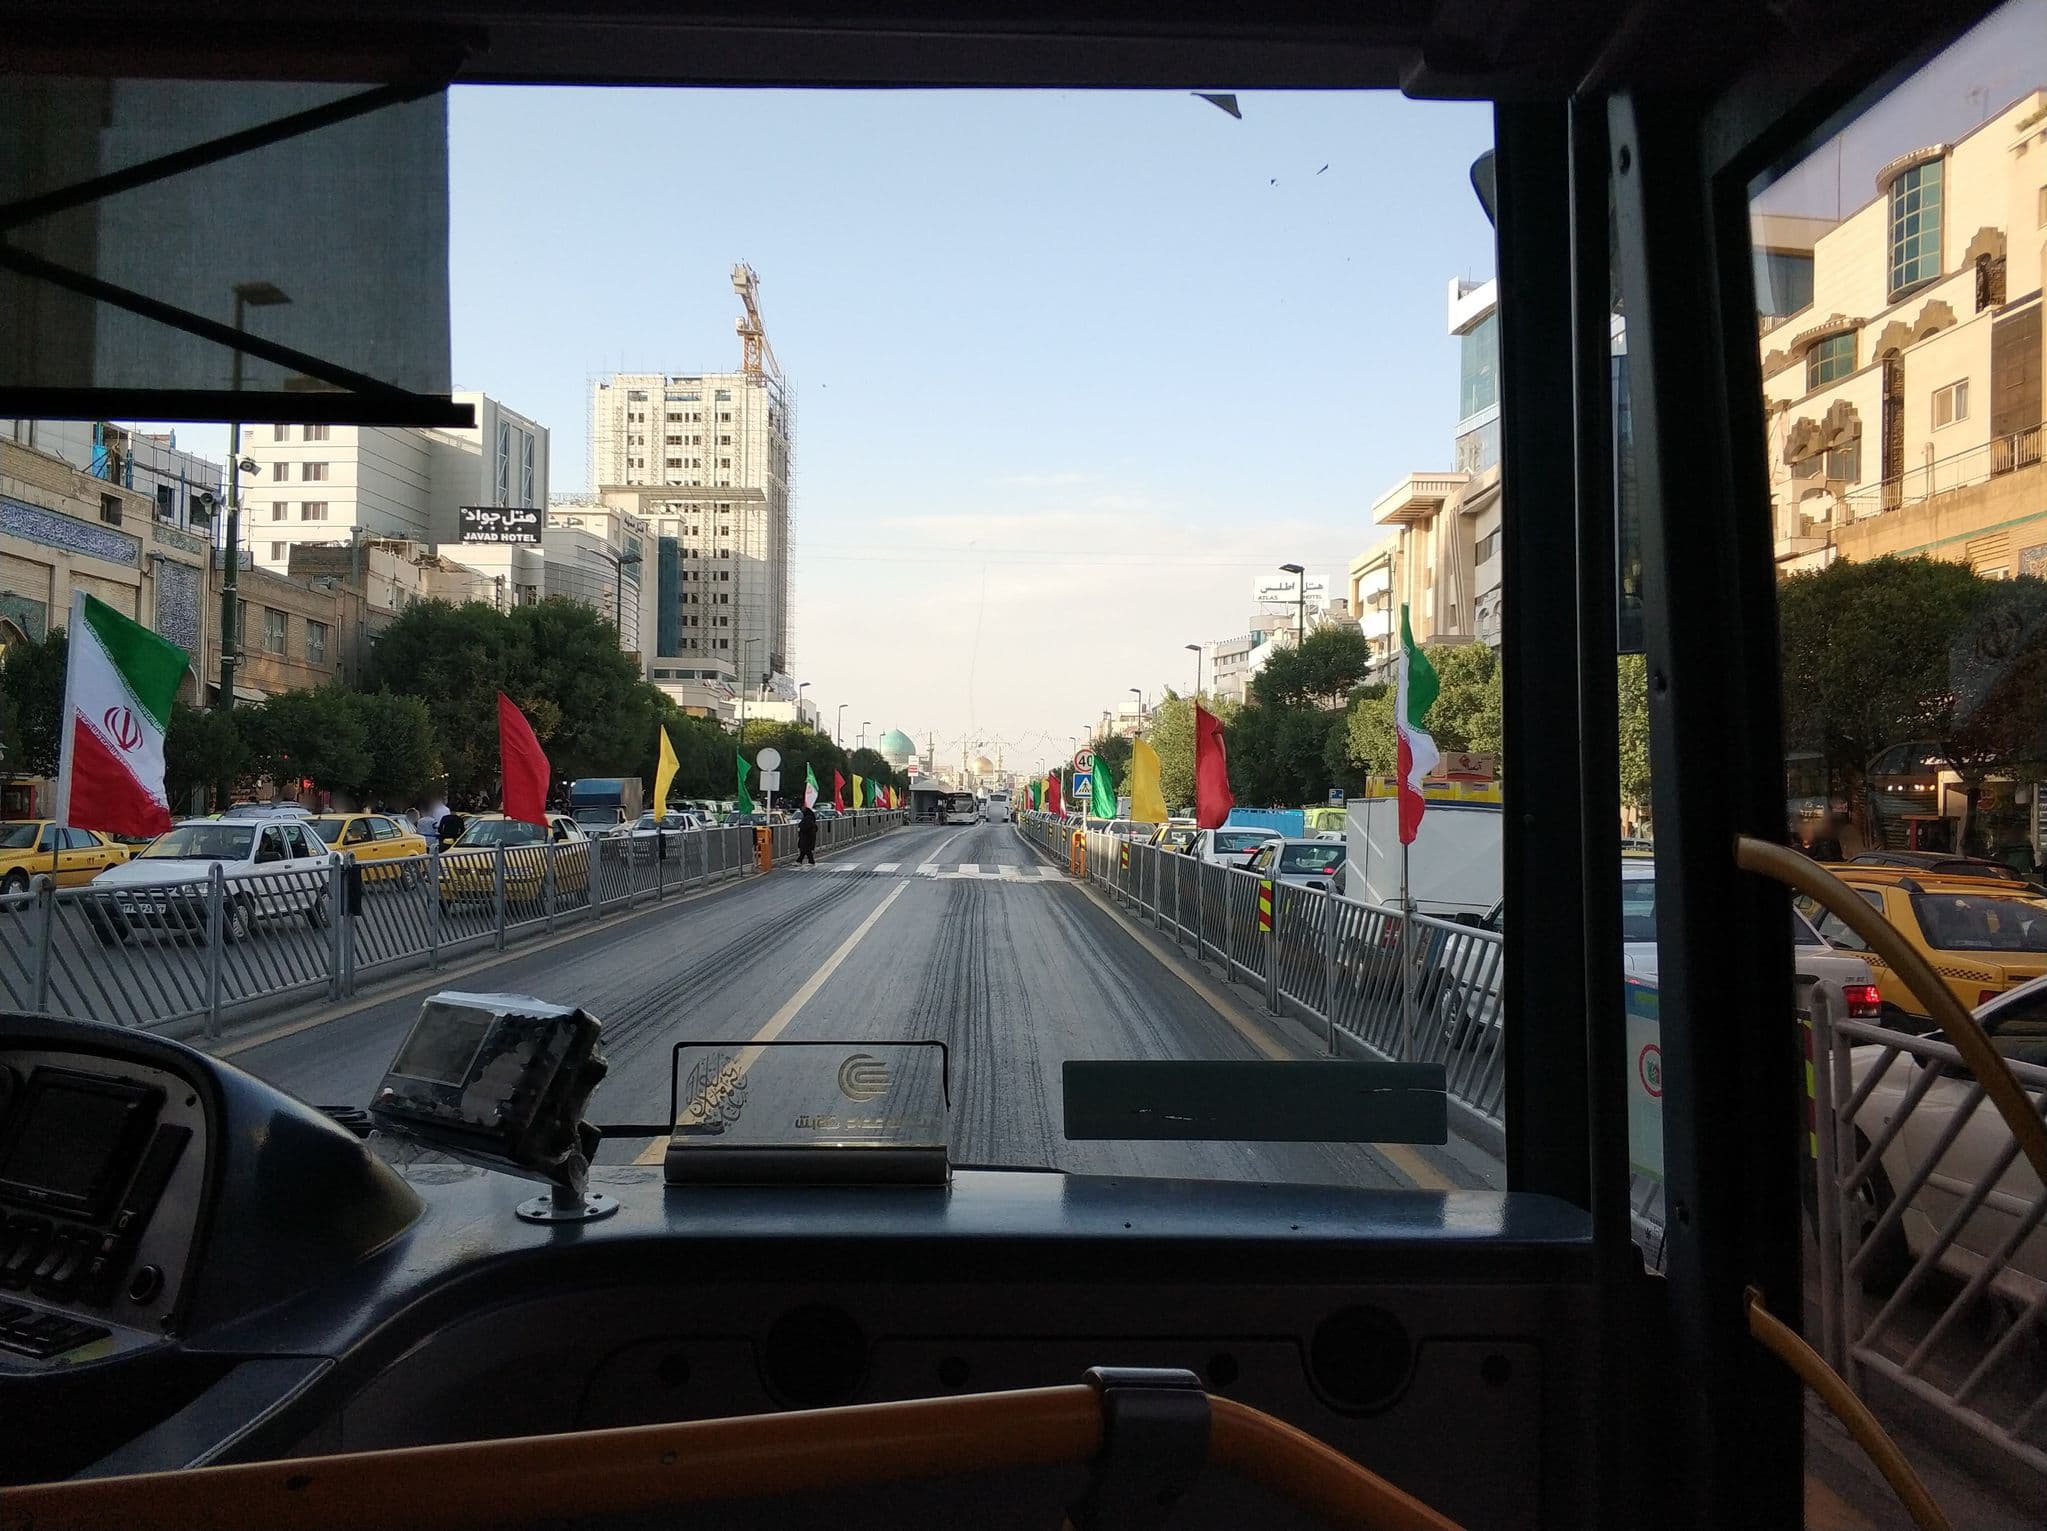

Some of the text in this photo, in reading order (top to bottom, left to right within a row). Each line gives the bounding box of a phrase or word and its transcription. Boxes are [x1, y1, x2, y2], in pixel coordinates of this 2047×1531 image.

[502, 510, 537, 526] هتل
[501, 534, 536, 542] HOTEL
[1260, 582, 1323, 593] هتل اطلس
[1079, 755, 1092, 767] 40
